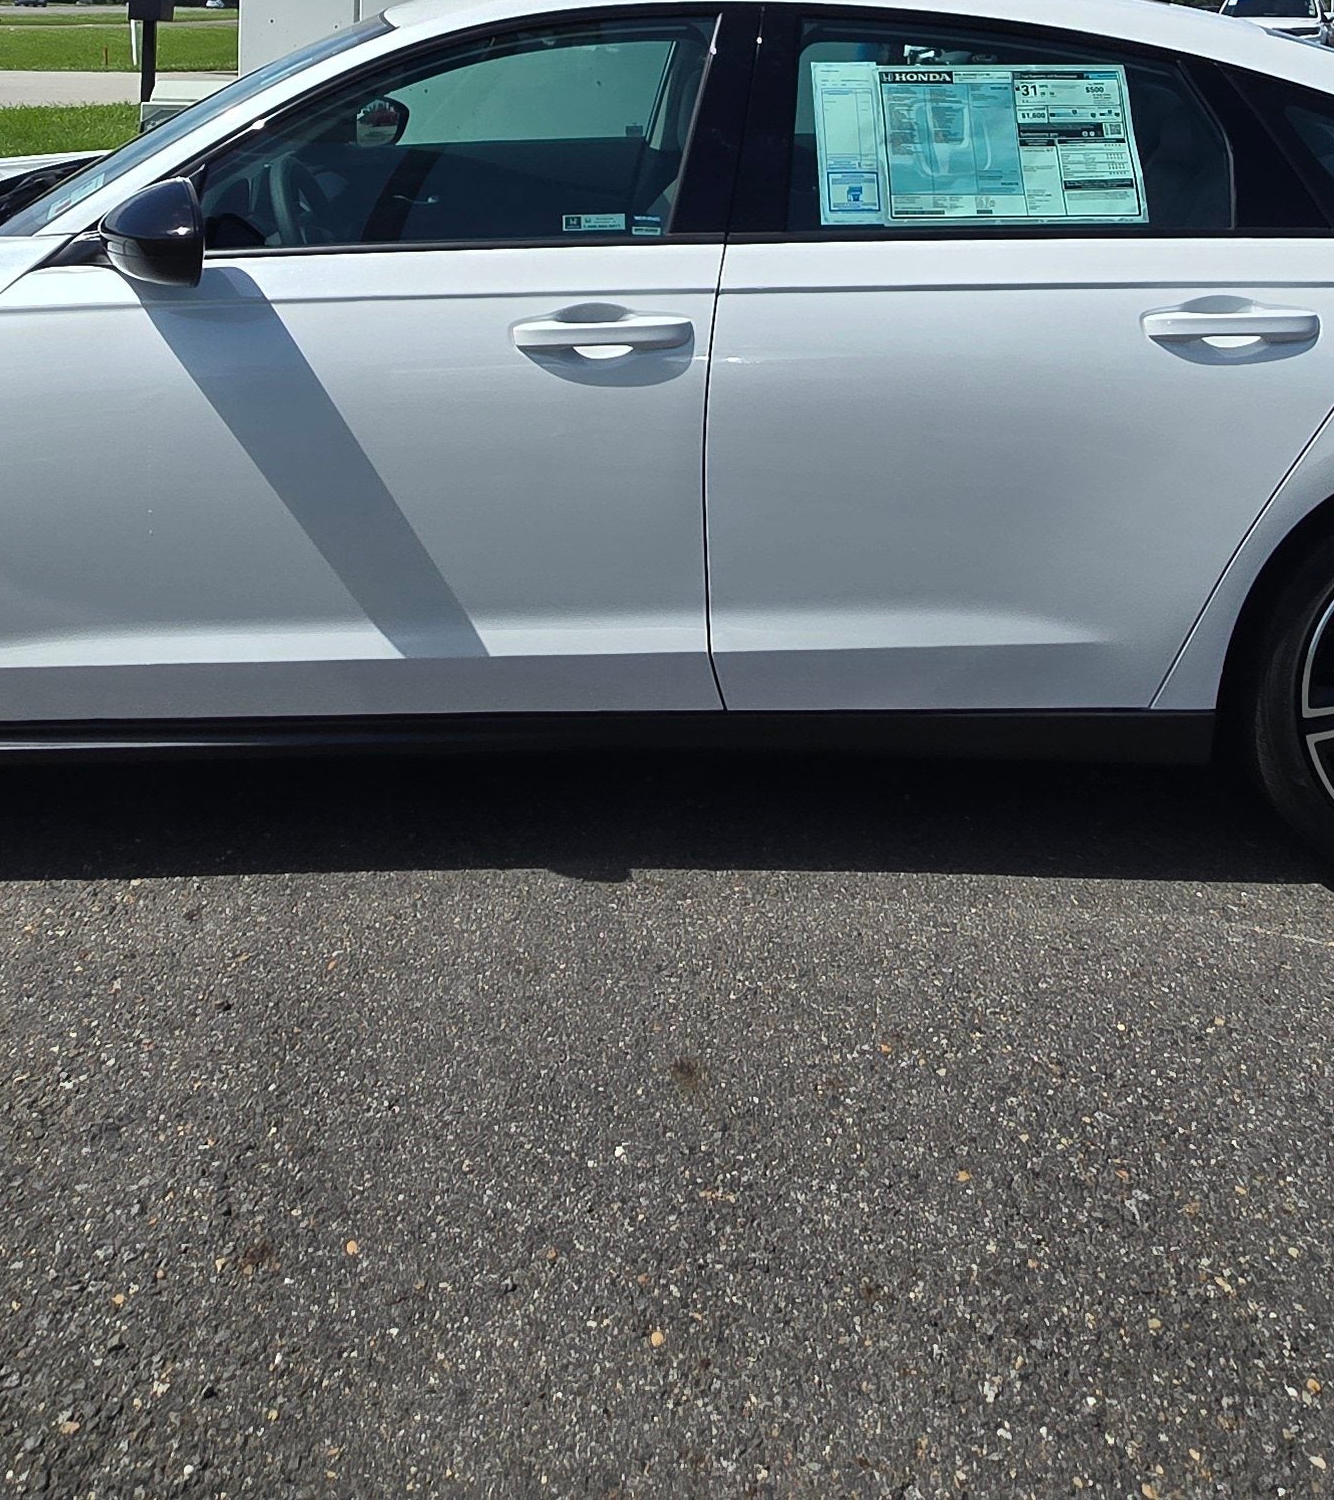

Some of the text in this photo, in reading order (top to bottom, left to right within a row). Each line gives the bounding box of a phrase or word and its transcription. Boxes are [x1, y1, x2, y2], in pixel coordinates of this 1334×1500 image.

[894, 73, 952, 82] HONDA
[1021, 84, 1038, 97] 31
[1085, 86, 1105, 94] $500
